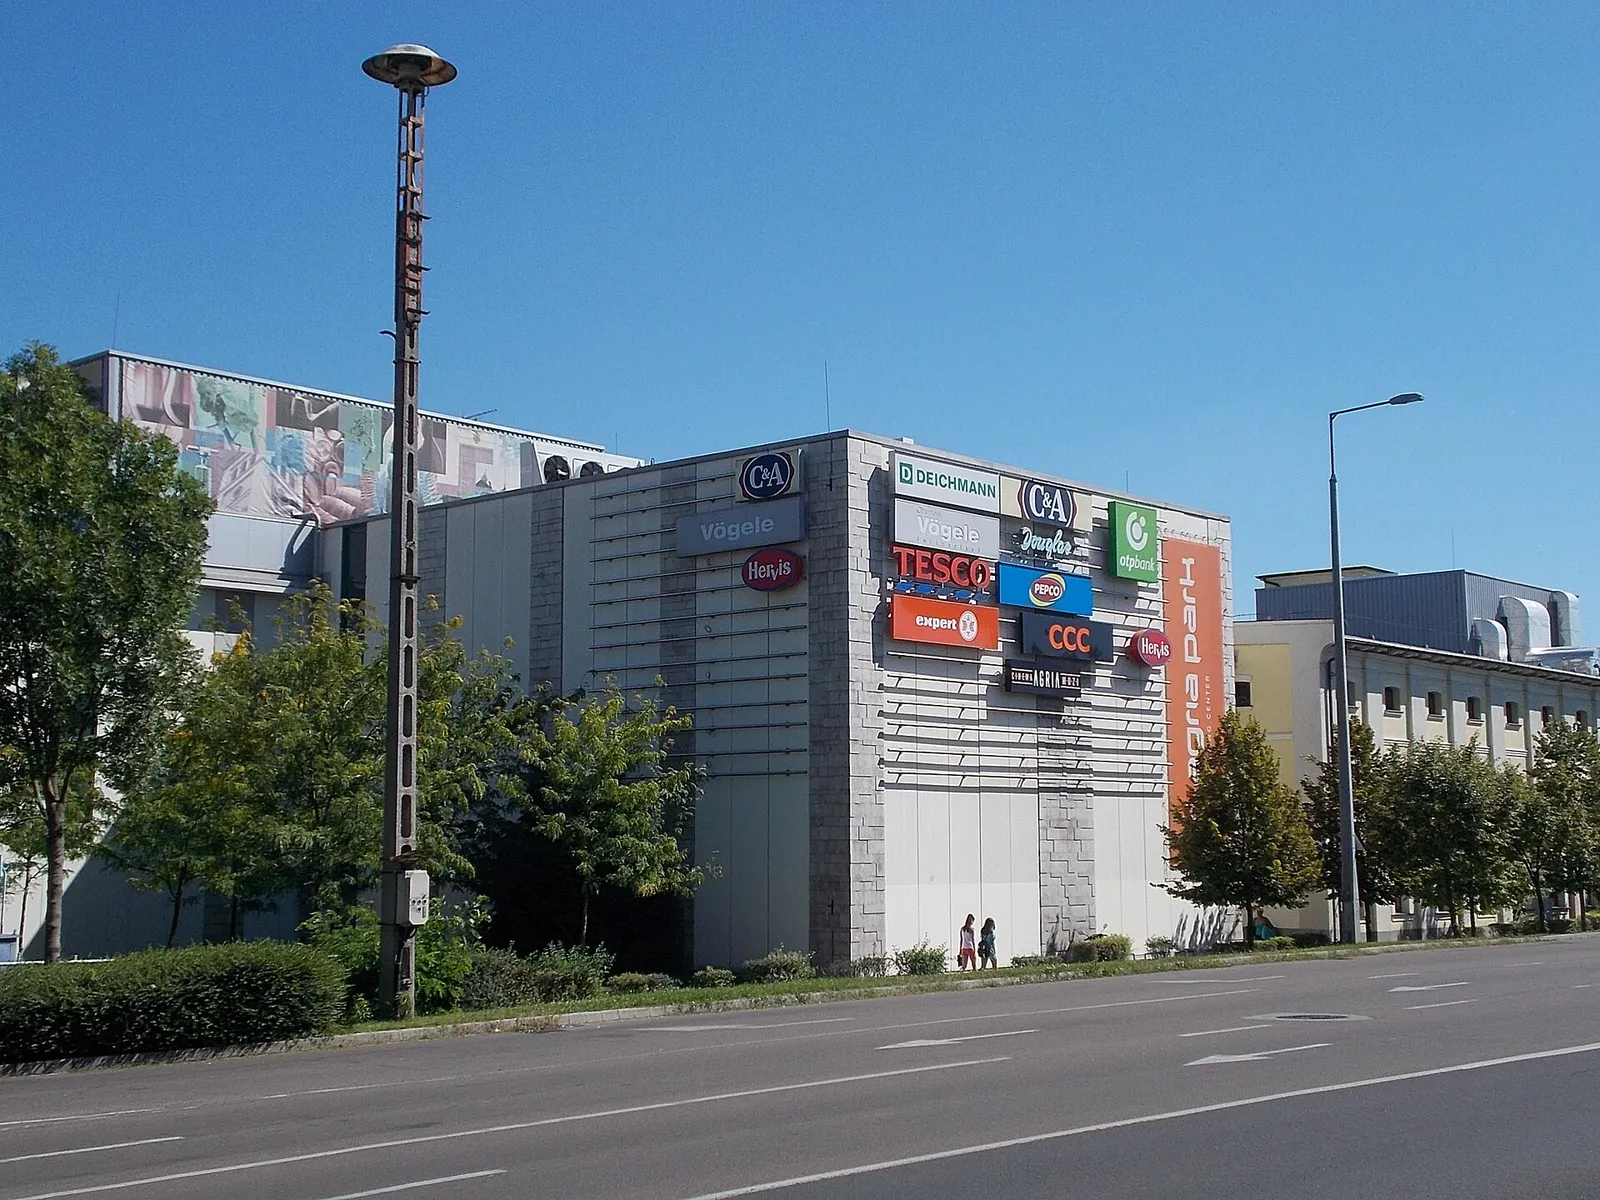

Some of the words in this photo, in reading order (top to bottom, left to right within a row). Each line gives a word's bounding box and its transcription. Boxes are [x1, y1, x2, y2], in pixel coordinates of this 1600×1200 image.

[749, 462, 784, 489] C&A
[916, 469, 996, 499] DEICHMANN
[1029, 484, 1068, 523] C&A
[700, 516, 774, 541] Vögele
[916, 515, 981, 543] Vögele
[748, 559, 791, 581] Hervis
[893, 546, 991, 589] TESCO
[1120, 555, 1155, 572] otpbank
[1034, 583, 1060, 597] PEPCO
[915, 615, 958, 630] expert
[1179, 557, 1202, 664] park
[1049, 624, 1091, 653] CCC
[1141, 637, 1170, 659] Hervis
[1033, 669, 1060, 689] AGRIA
